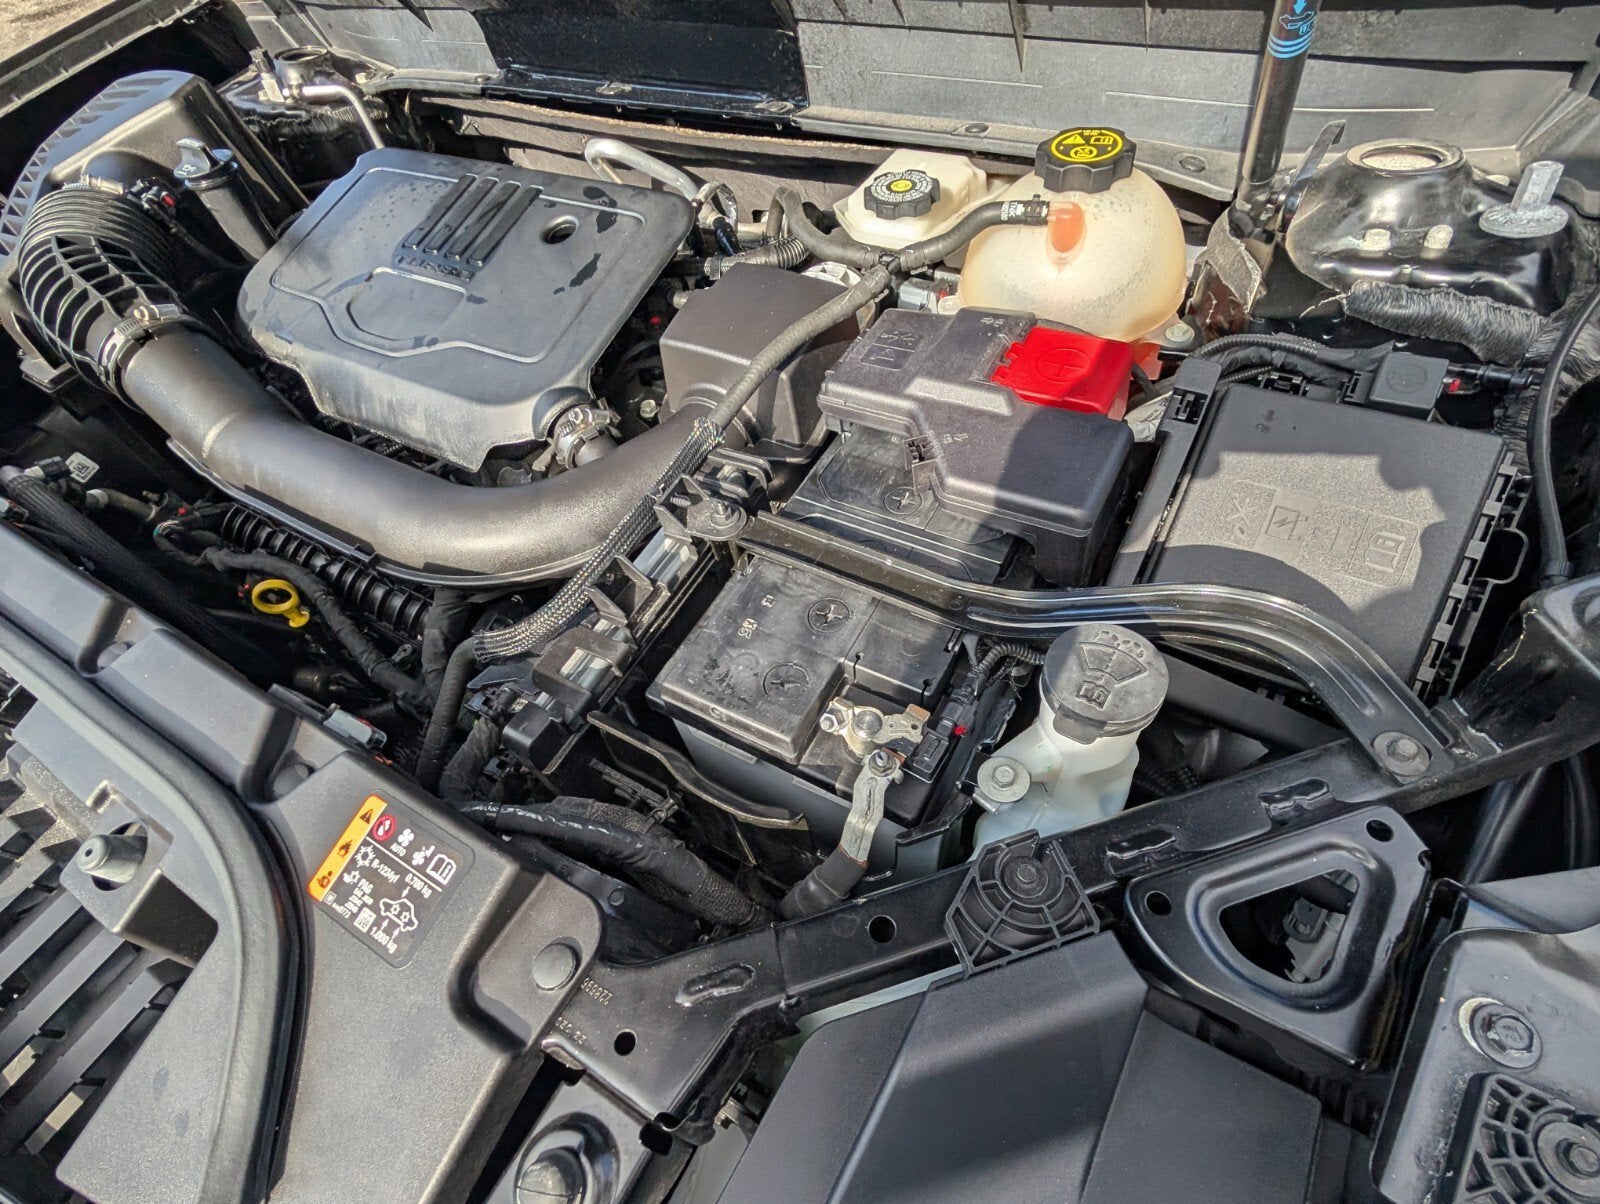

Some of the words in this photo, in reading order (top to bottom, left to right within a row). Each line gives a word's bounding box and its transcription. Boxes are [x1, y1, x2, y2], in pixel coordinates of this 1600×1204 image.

[389, 842, 407, 857] AUTO
[358, 878, 374, 895] PAG
[420, 884, 433, 899] kg
[370, 926, 390, 945] 1.000
[386, 940, 398, 954] kg
